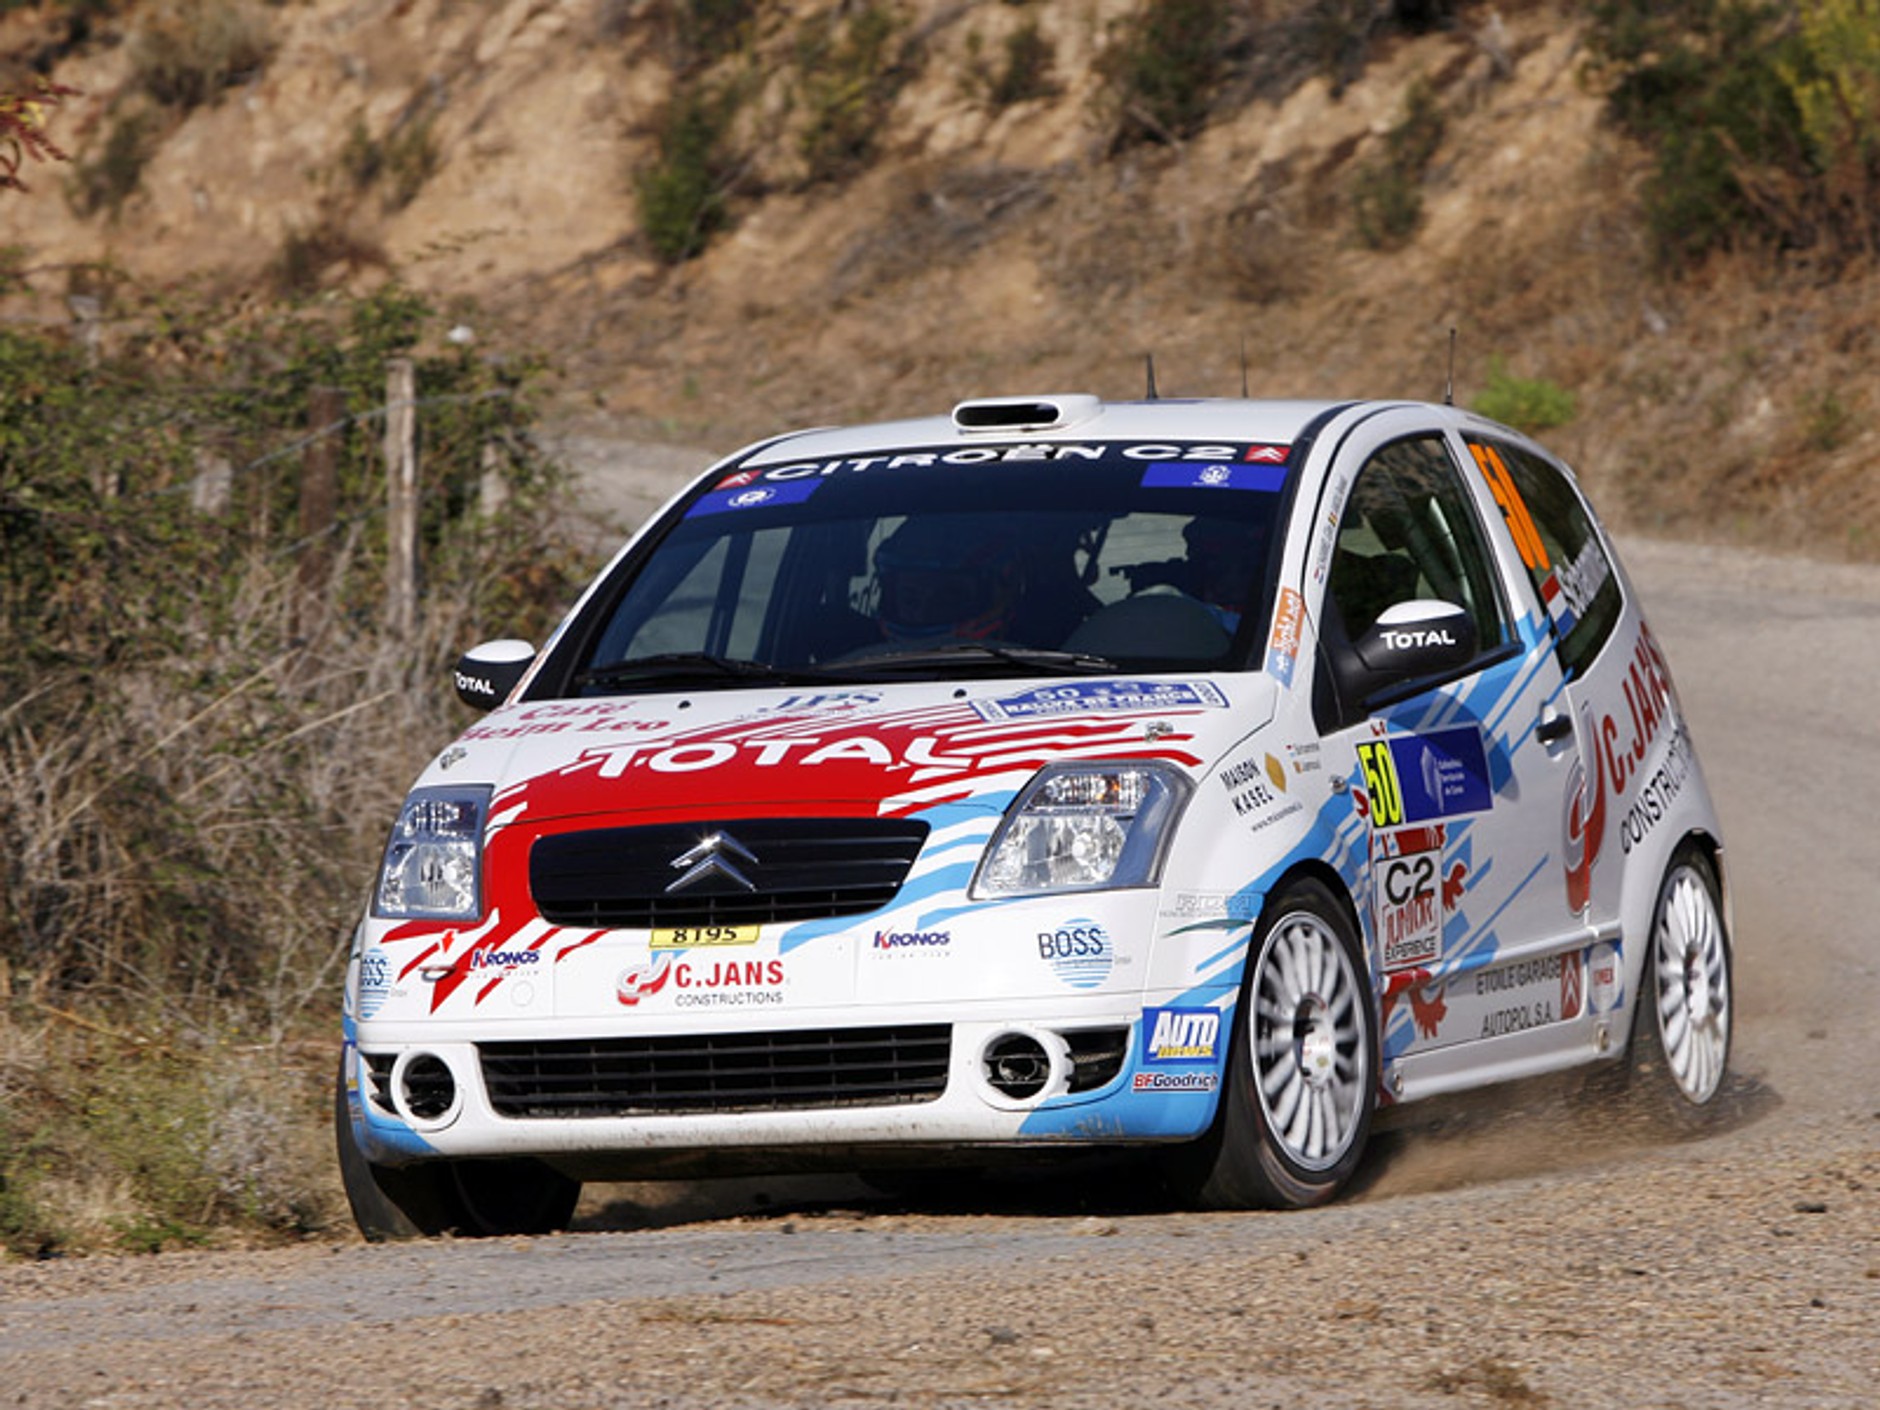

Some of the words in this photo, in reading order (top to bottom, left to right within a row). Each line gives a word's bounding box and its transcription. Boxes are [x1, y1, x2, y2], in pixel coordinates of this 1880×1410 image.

[1122, 444, 1238, 461] C2
[1467, 442, 1551, 571] 50
[1379, 630, 1456, 650] TOTAL
[454, 671, 495, 695] TOTAL
[1034, 687, 1080, 700] 50
[576, 716, 670, 732] Leo
[584, 736, 975, 778] TOTAL
[1219, 757, 1261, 791] MAISON
[1358, 742, 1401, 826] 50
[1231, 783, 1274, 817] KASEL
[1385, 856, 1434, 905] C2
[1384, 891, 1434, 950] JUNIOR
[671, 926, 738, 944] 8195
[873, 926, 950, 950] KRONOS
[1037, 927, 1103, 960] BOSS
[1385, 936, 1436, 960] EXPERIENCE
[472, 948, 541, 968] KRONOS
[675, 960, 784, 988] C.JANS
[1476, 966, 1514, 995] ETOILE
[675, 992, 783, 1007] CONSTRUCTIONS
[1149, 1011, 1219, 1053] AUTO
[1133, 1073, 1218, 1088] BFGoodrich
